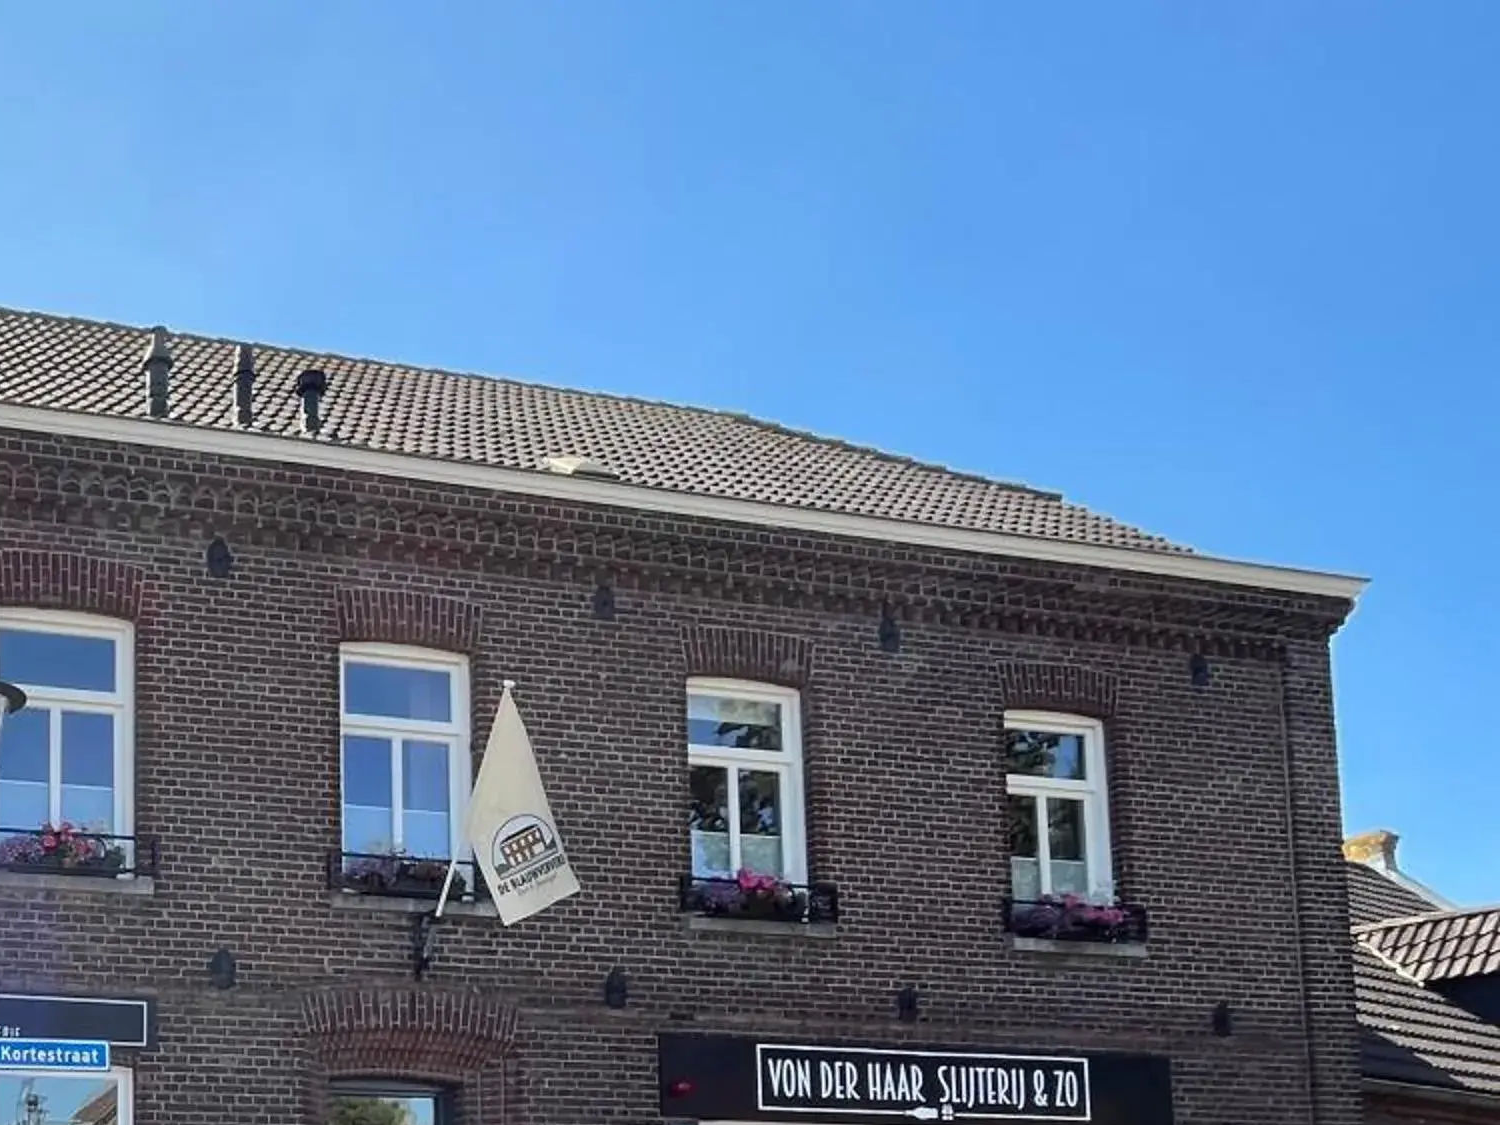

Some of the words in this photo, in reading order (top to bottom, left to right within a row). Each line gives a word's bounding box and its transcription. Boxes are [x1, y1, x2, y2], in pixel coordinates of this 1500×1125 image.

[0, 1044, 100, 1064] Kortestraat
[767, 1057, 812, 1099] VON
[819, 1060, 861, 1100] DER
[867, 1061, 927, 1103] HAAR
[937, 1064, 1025, 1111] SLIJTERIJ
[1032, 1068, 1049, 1107] &
[1052, 1069, 1079, 1108] ZO
